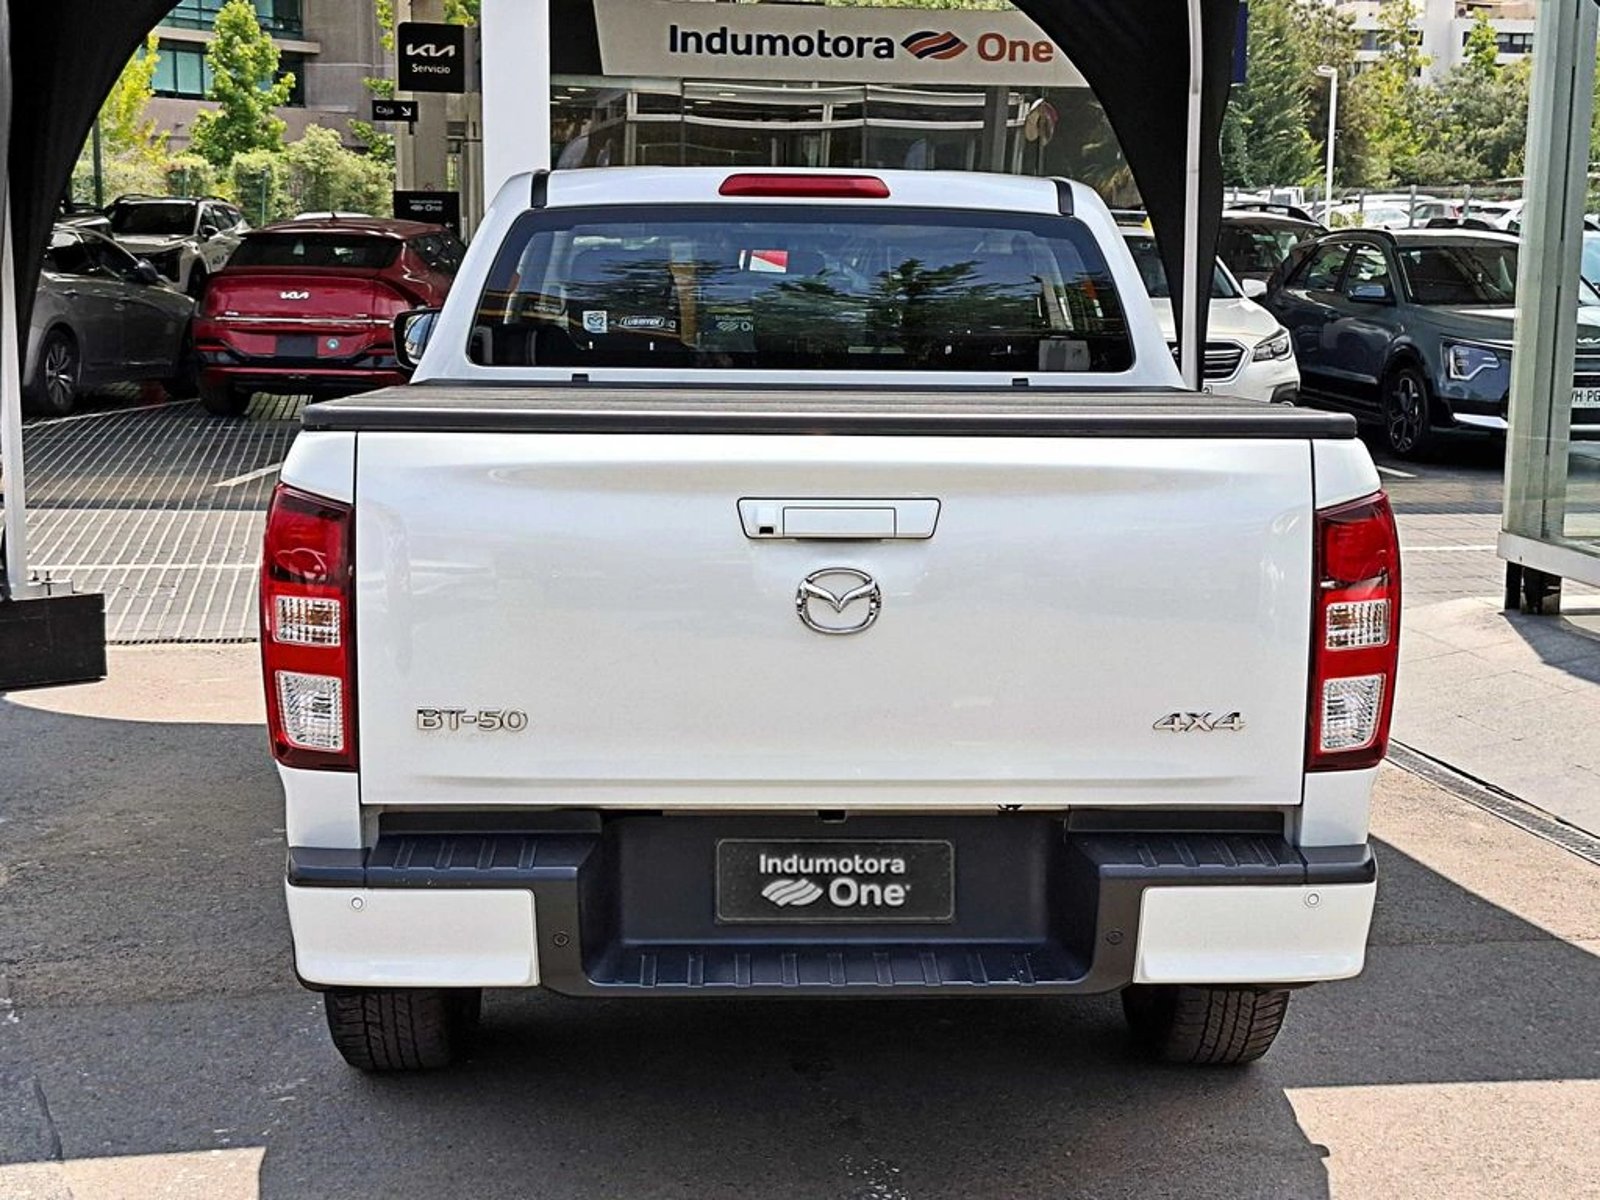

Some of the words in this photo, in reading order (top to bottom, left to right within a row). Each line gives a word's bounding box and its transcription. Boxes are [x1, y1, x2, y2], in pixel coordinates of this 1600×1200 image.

[406, 43, 455, 57] KIA
[669, 24, 894, 58] Indumotora
[977, 32, 1054, 62] One
[412, 63, 451, 74] Servicio
[417, 708, 528, 731] BT-50
[759, 854, 906, 874] Indumotora
